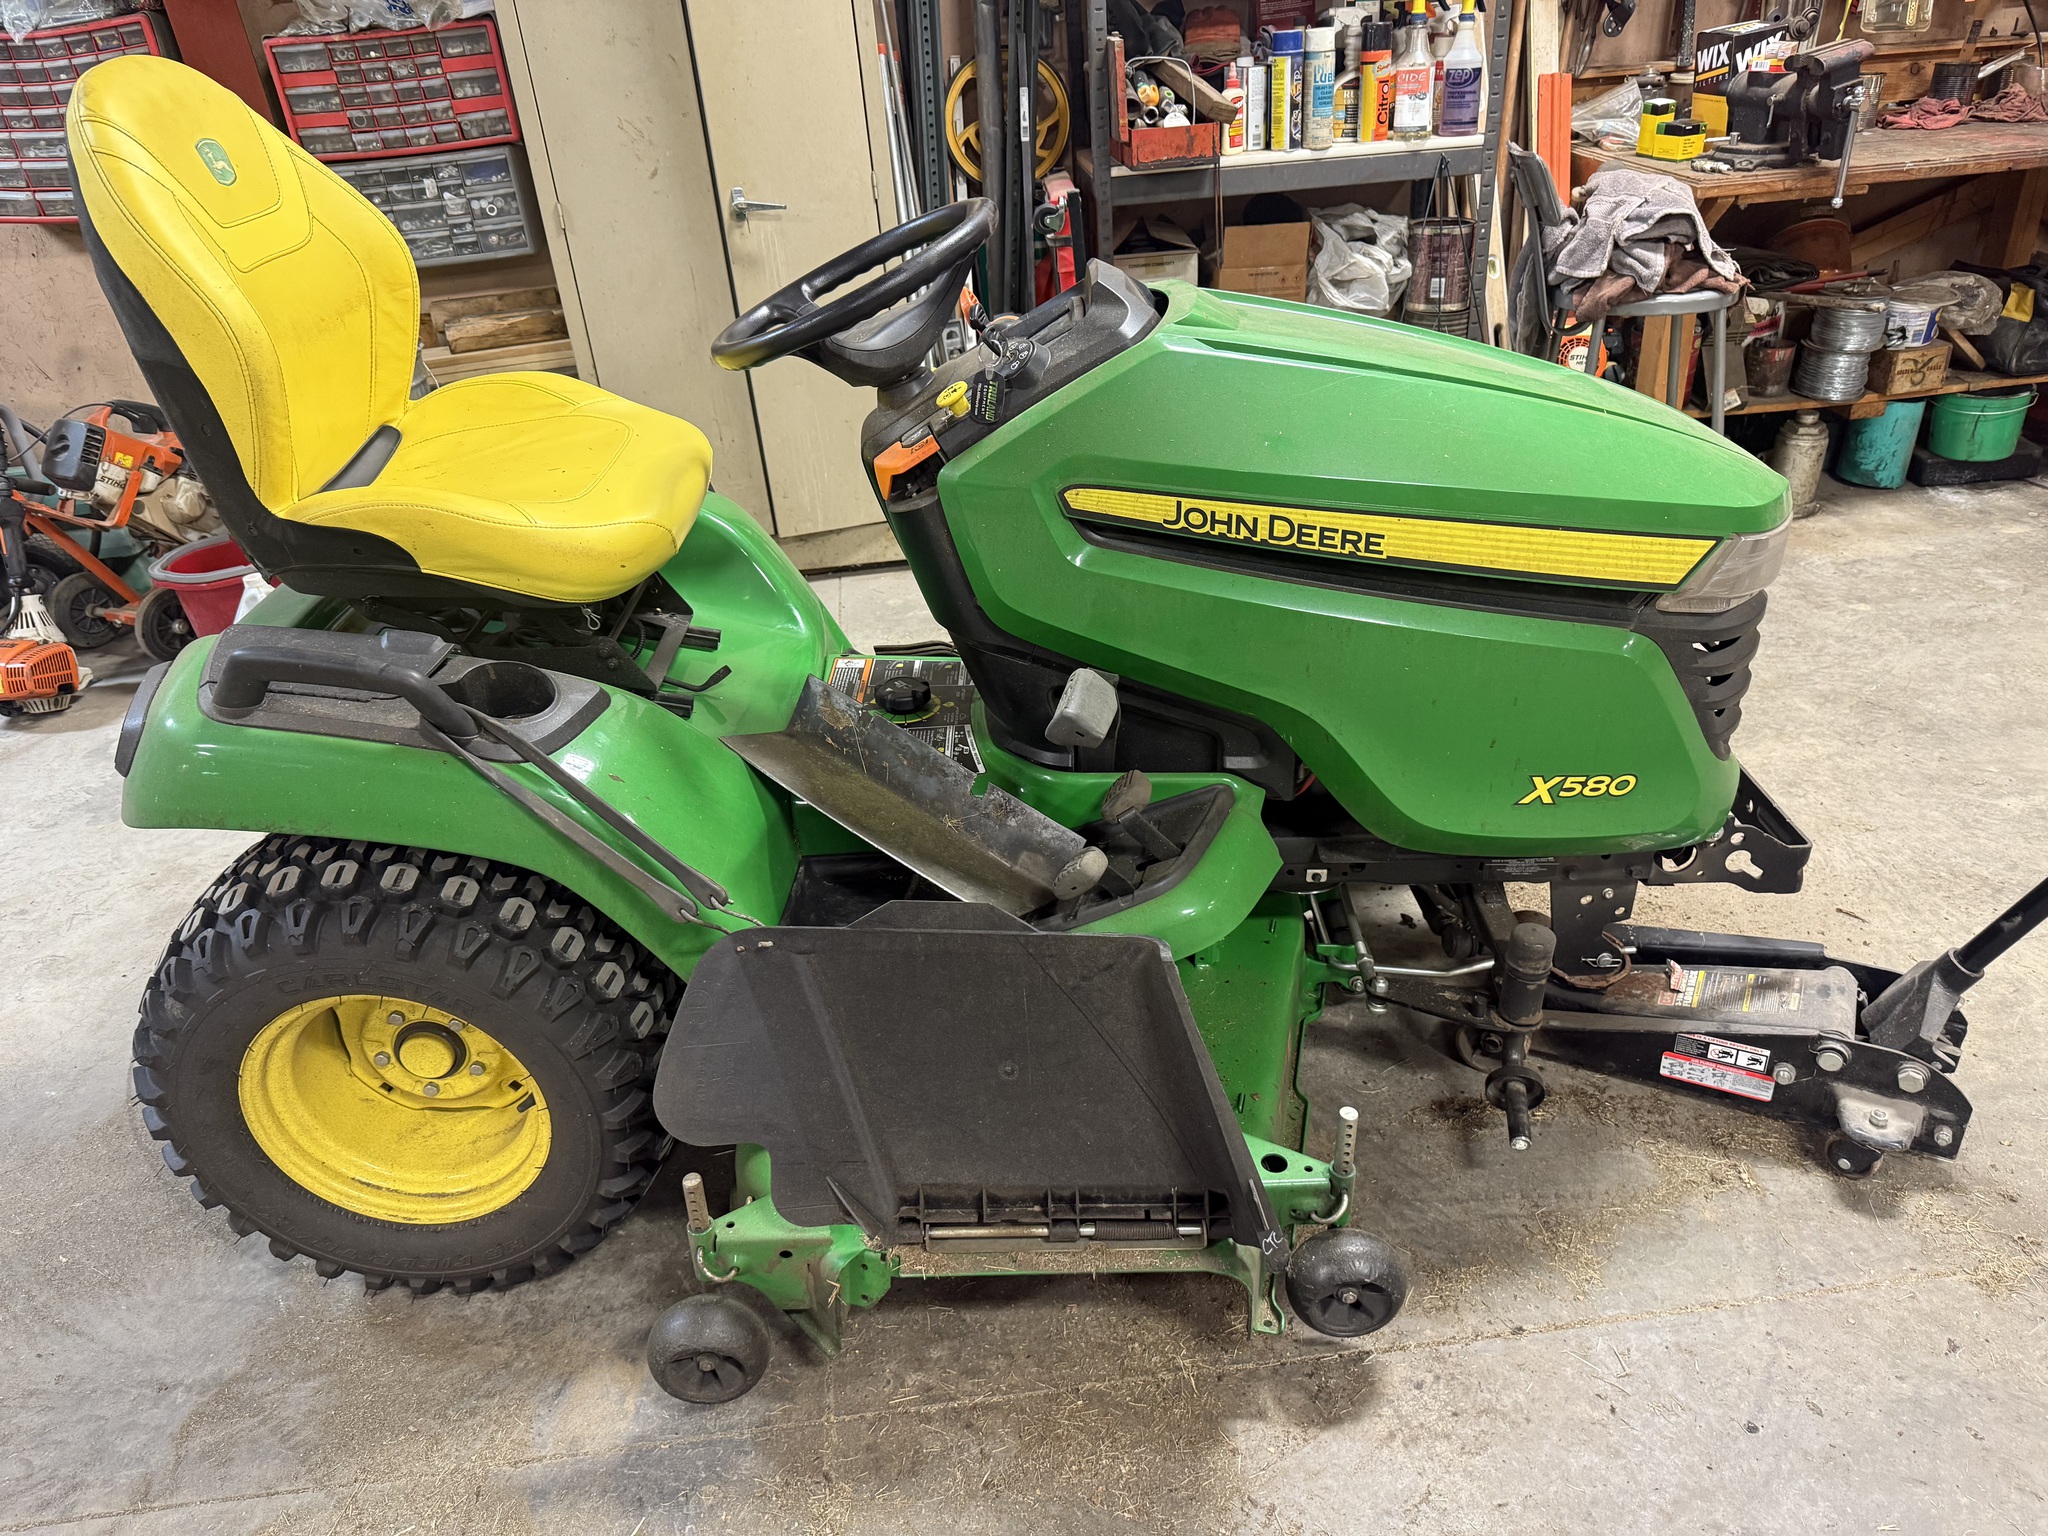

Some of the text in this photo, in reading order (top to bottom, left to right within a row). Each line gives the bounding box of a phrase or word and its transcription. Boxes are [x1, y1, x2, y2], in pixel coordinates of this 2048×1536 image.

[1697, 41, 1730, 73] WIX
[1735, 30, 1784, 72] WIX
[1694, 73, 1730, 88] FILTERS
[1377, 80, 1389, 125] Citrol
[1896, 368, 1915, 376] GOLDEN
[985, 381, 999, 421] TRULAND
[1162, 500, 1387, 558] JOHN DEERE
[1514, 774, 1638, 805] X580
